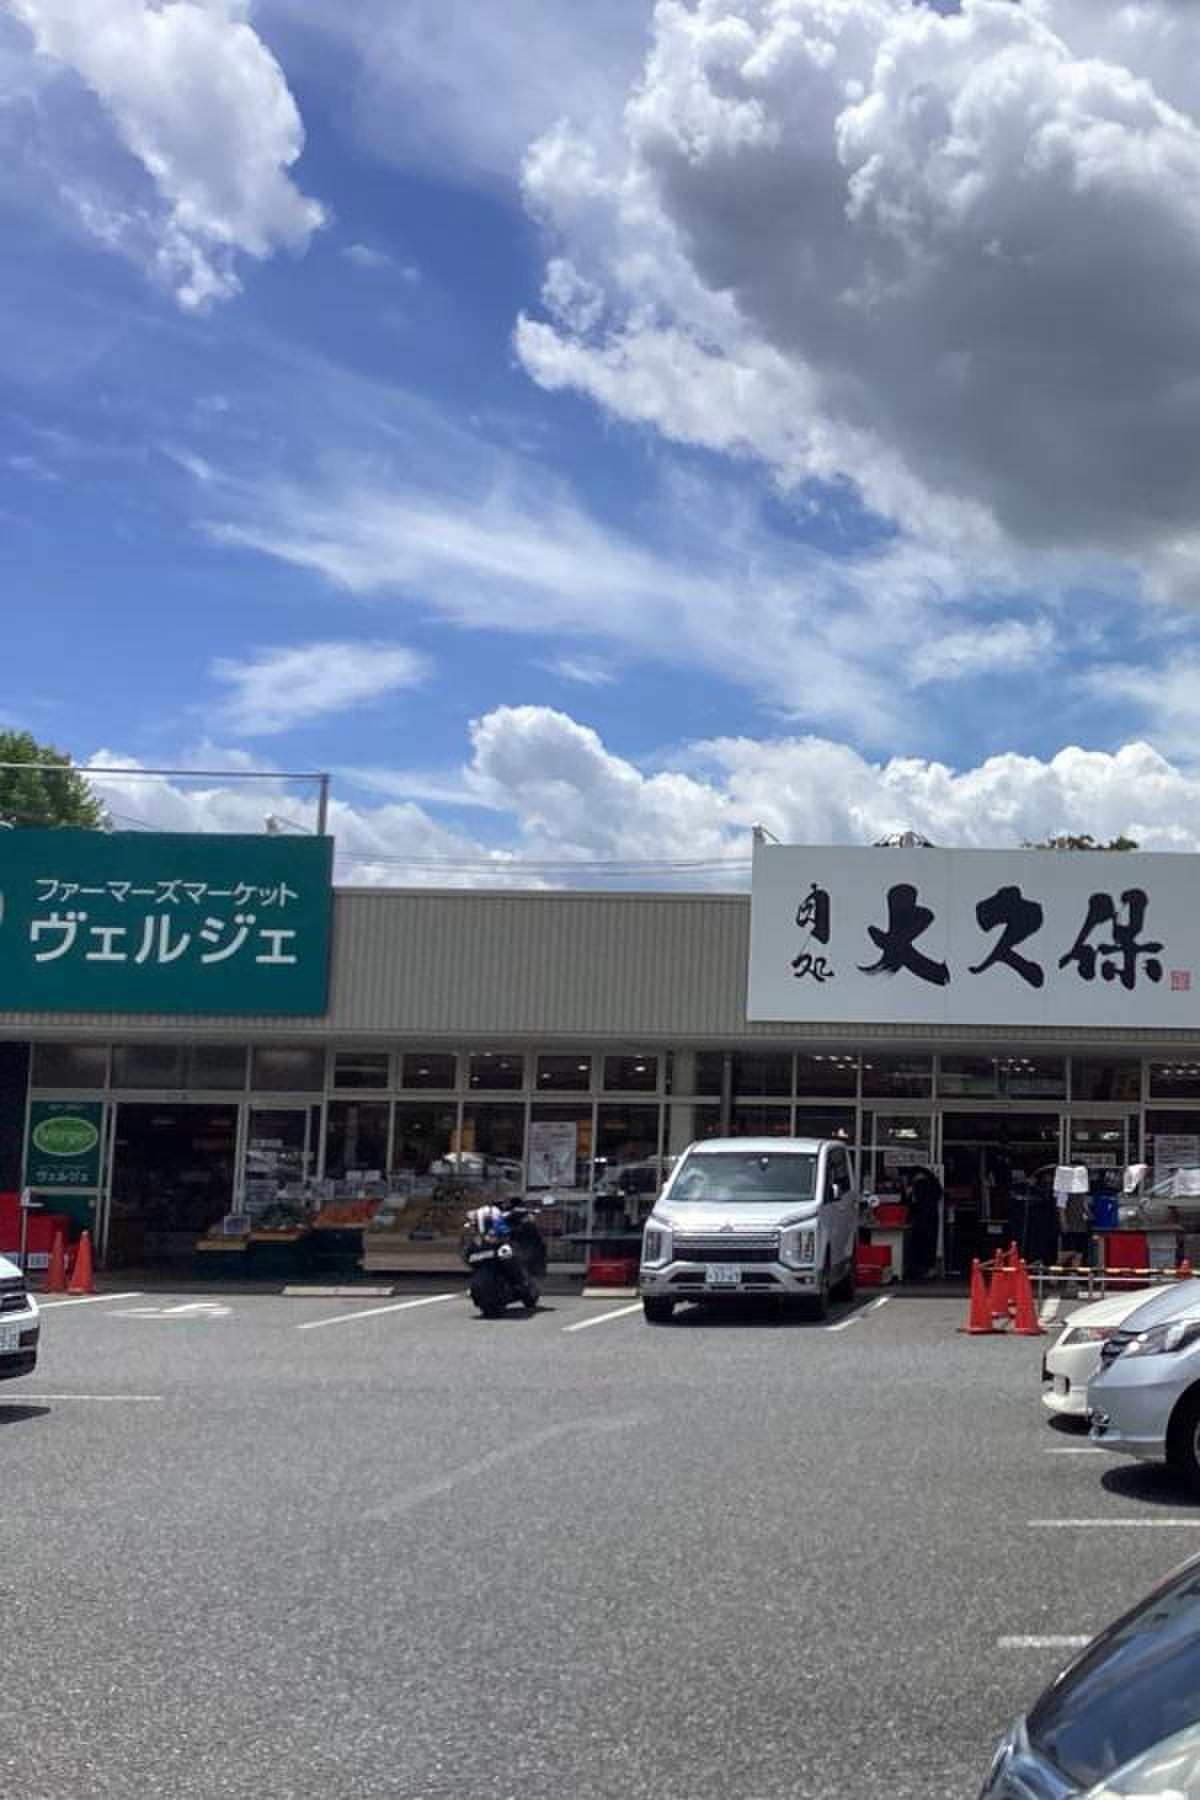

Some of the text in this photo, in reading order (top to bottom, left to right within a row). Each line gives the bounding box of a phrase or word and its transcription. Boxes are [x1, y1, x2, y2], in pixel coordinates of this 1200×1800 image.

[35, 879, 299, 907] ファーマーズマーケット
[30, 911, 297, 964] ヴェルジェ
[857, 883, 1165, 990] 大久保
